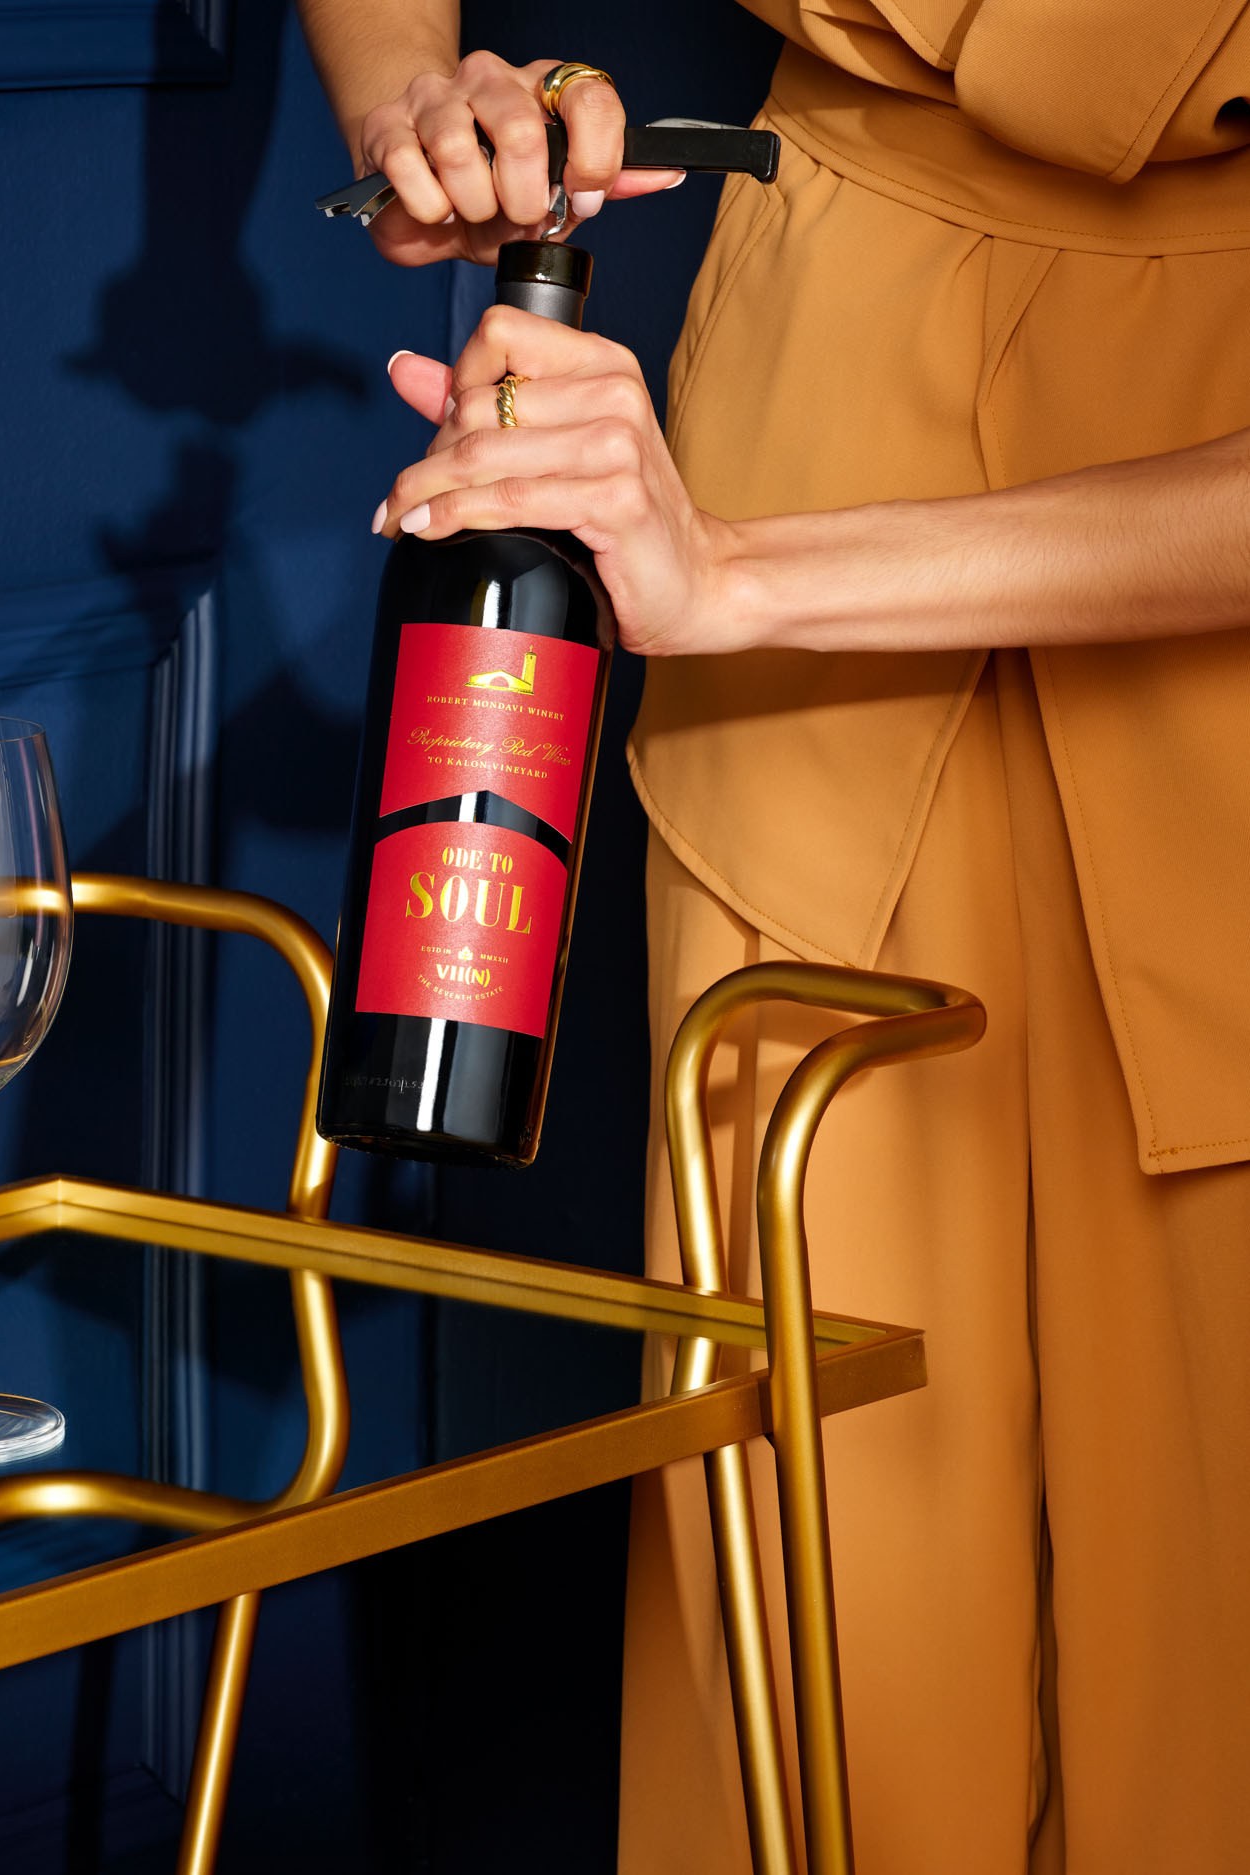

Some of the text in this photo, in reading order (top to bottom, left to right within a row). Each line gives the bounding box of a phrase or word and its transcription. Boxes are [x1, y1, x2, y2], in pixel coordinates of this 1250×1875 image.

[427, 695, 565, 721] ROBERT MONDAVI WINERY
[407, 726, 572, 766] Proprietary Red Wine
[427, 756, 548, 779] TO KALON VINEYARD
[441, 847, 513, 874] ODE TO
[405, 871, 532, 935] SOUL
[417, 974, 504, 1001] THE SEVENTH ESTATE
